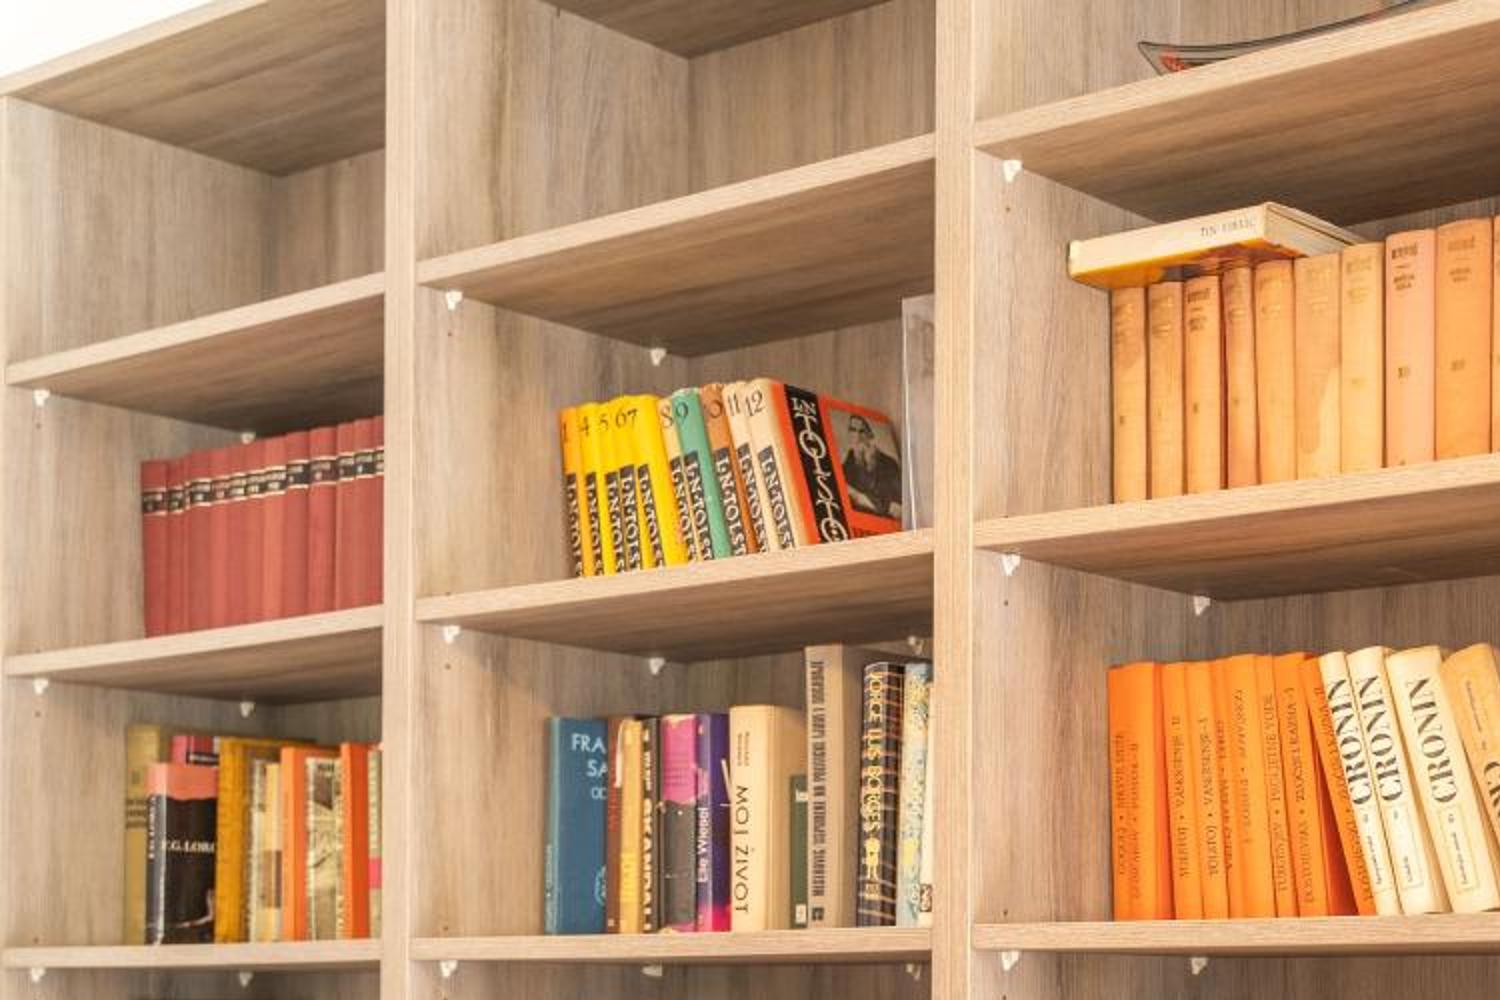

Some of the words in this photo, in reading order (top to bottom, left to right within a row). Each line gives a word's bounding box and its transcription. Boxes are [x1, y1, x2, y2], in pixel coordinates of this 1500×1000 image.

[1327, 679, 1372, 805] CRONIN
[1358, 675, 1402, 801] CRONIN
[1408, 676, 1457, 803] CRONIN
[735, 785, 750, 835] MOJ
[734, 845, 756, 914] ŽIVOT
